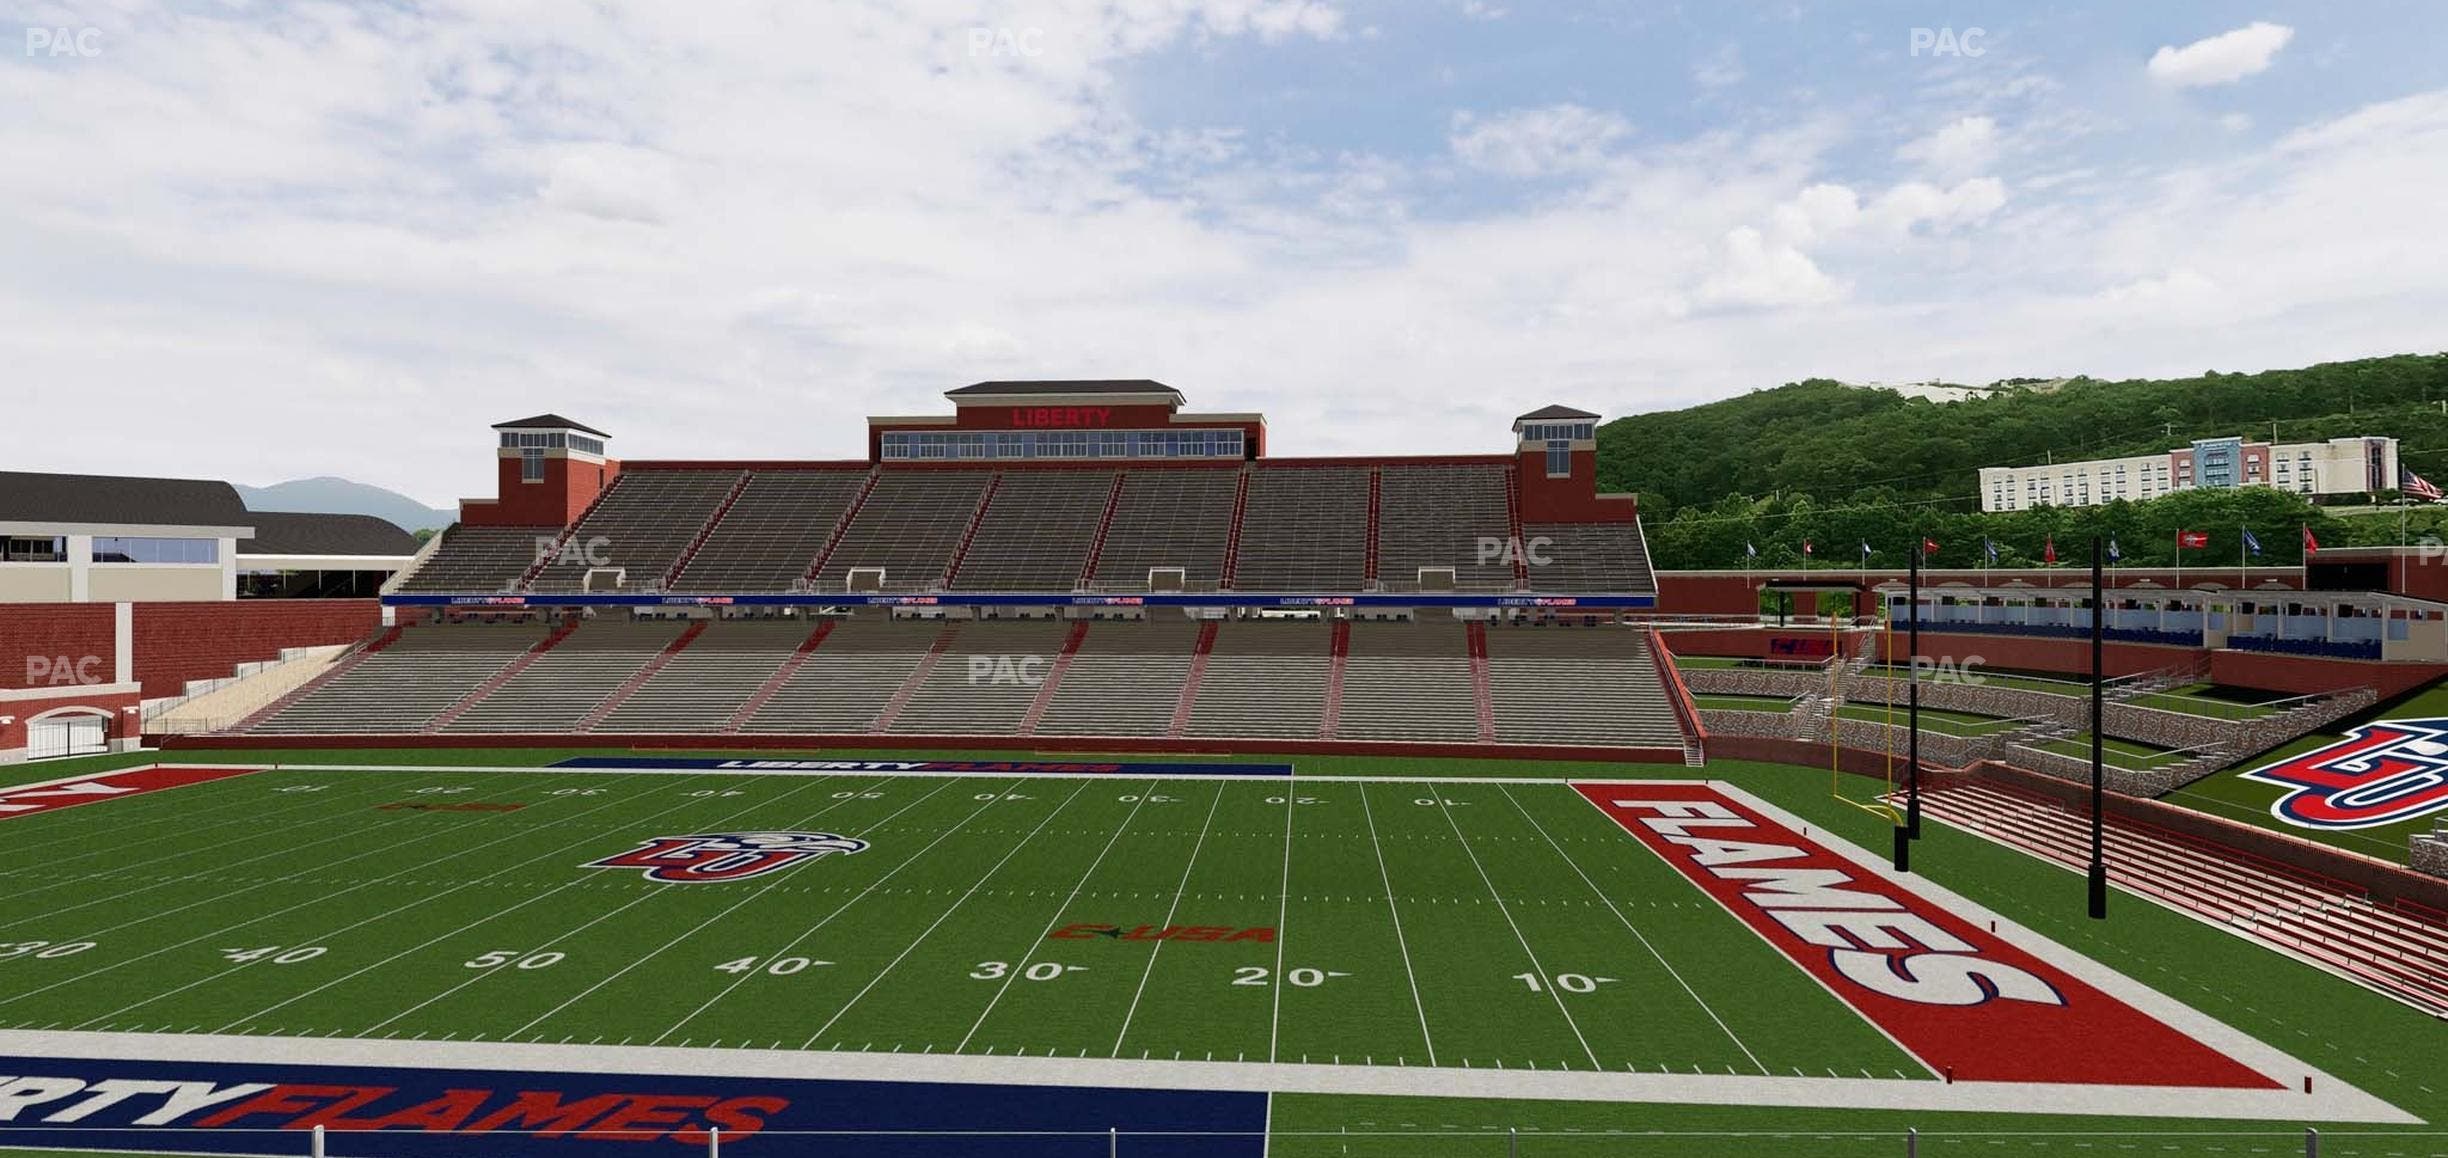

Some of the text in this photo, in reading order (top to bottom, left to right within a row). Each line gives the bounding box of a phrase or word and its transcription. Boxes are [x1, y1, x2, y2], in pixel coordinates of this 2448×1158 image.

[1013, 407, 1111, 427] LIBERTY
[1608, 799, 2071, 1008] FLAMES
[0, 941, 97, 958] 30
[226, 945, 328, 964] 40
[464, 951, 566, 970] 50
[714, 956, 812, 976] 40
[969, 962, 1063, 981] 30
[1231, 967, 1325, 987] 20
[1512, 972, 1597, 993] 10
[192, 1083, 790, 1145] FLAMES
